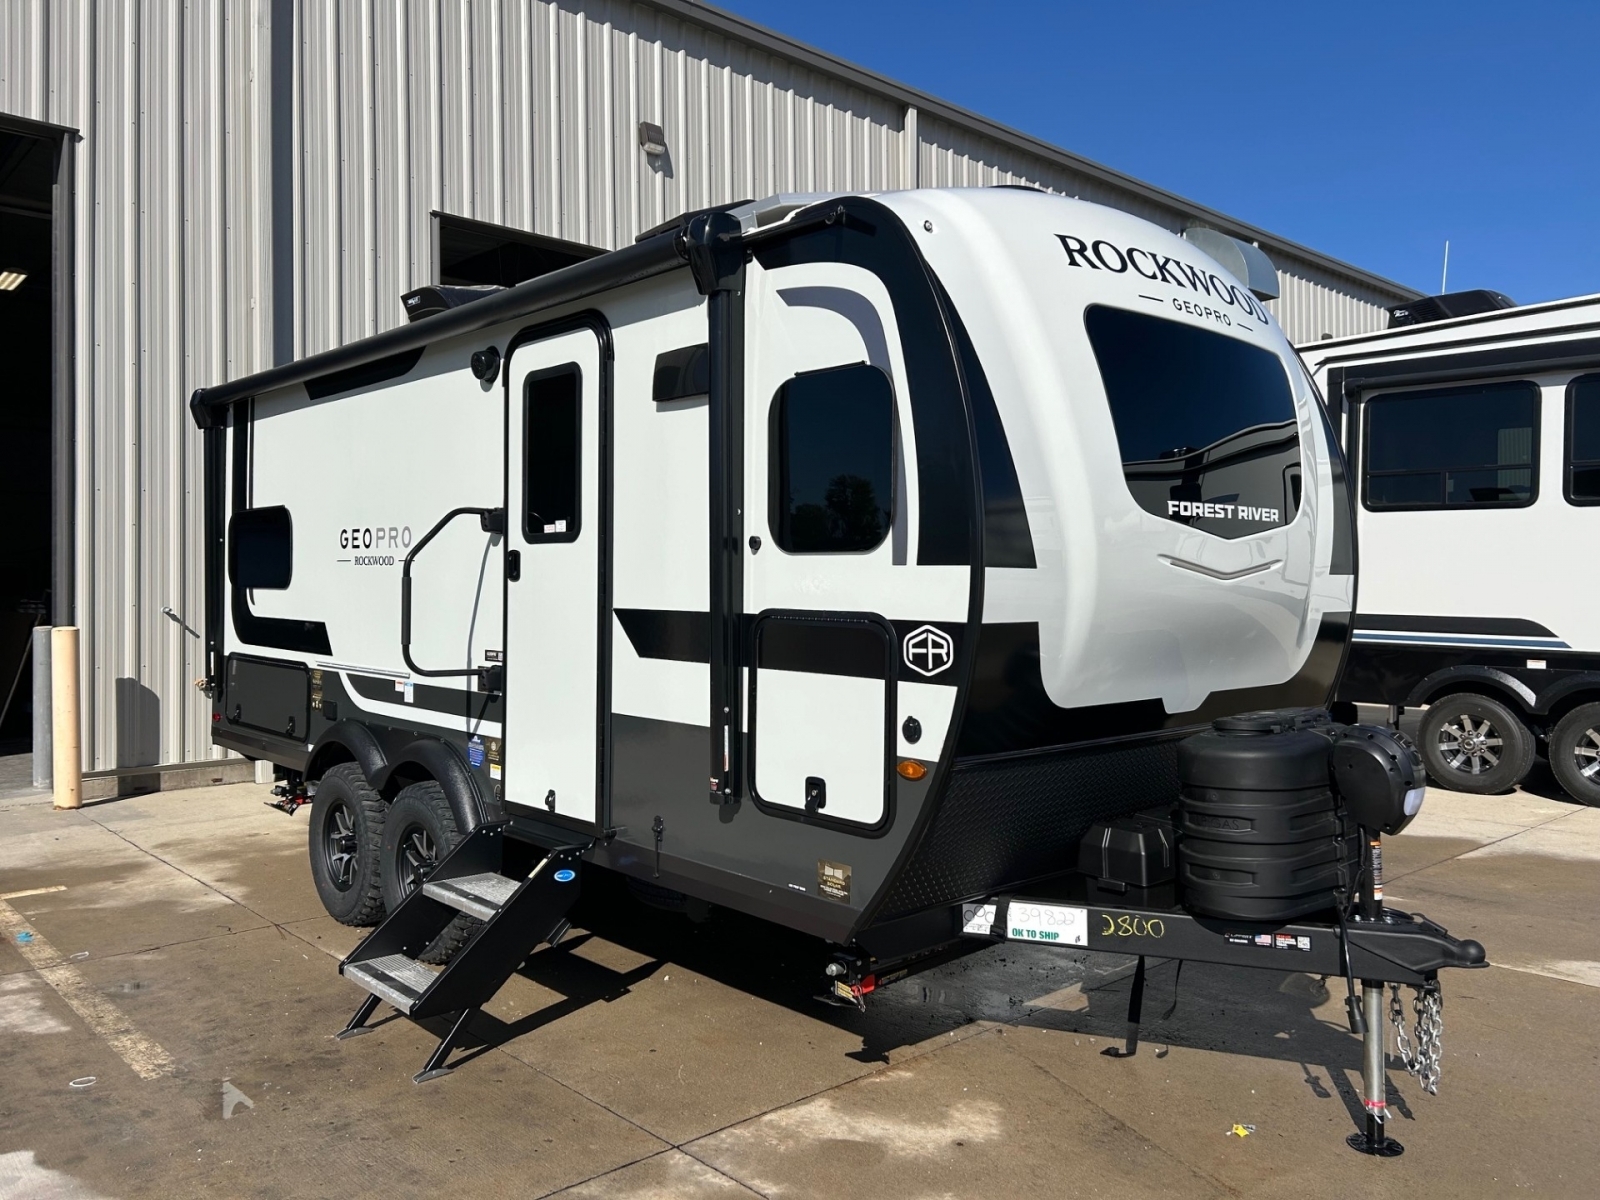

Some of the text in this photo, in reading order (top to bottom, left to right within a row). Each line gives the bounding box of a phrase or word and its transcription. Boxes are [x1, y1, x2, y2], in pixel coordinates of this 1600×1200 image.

[1053, 233, 1269, 325] ROCKWOOD
[1172, 298, 1231, 326] GEOPRO
[1167, 500, 1279, 522] FOREST RIVER
[340, 525, 412, 549] GEOPRO
[354, 556, 395, 566] ROCKWOOD
[1018, 907, 1075, 926] 39822
[1101, 914, 1165, 939] 2800
[1012, 928, 1060, 941] OK TO SHIP
